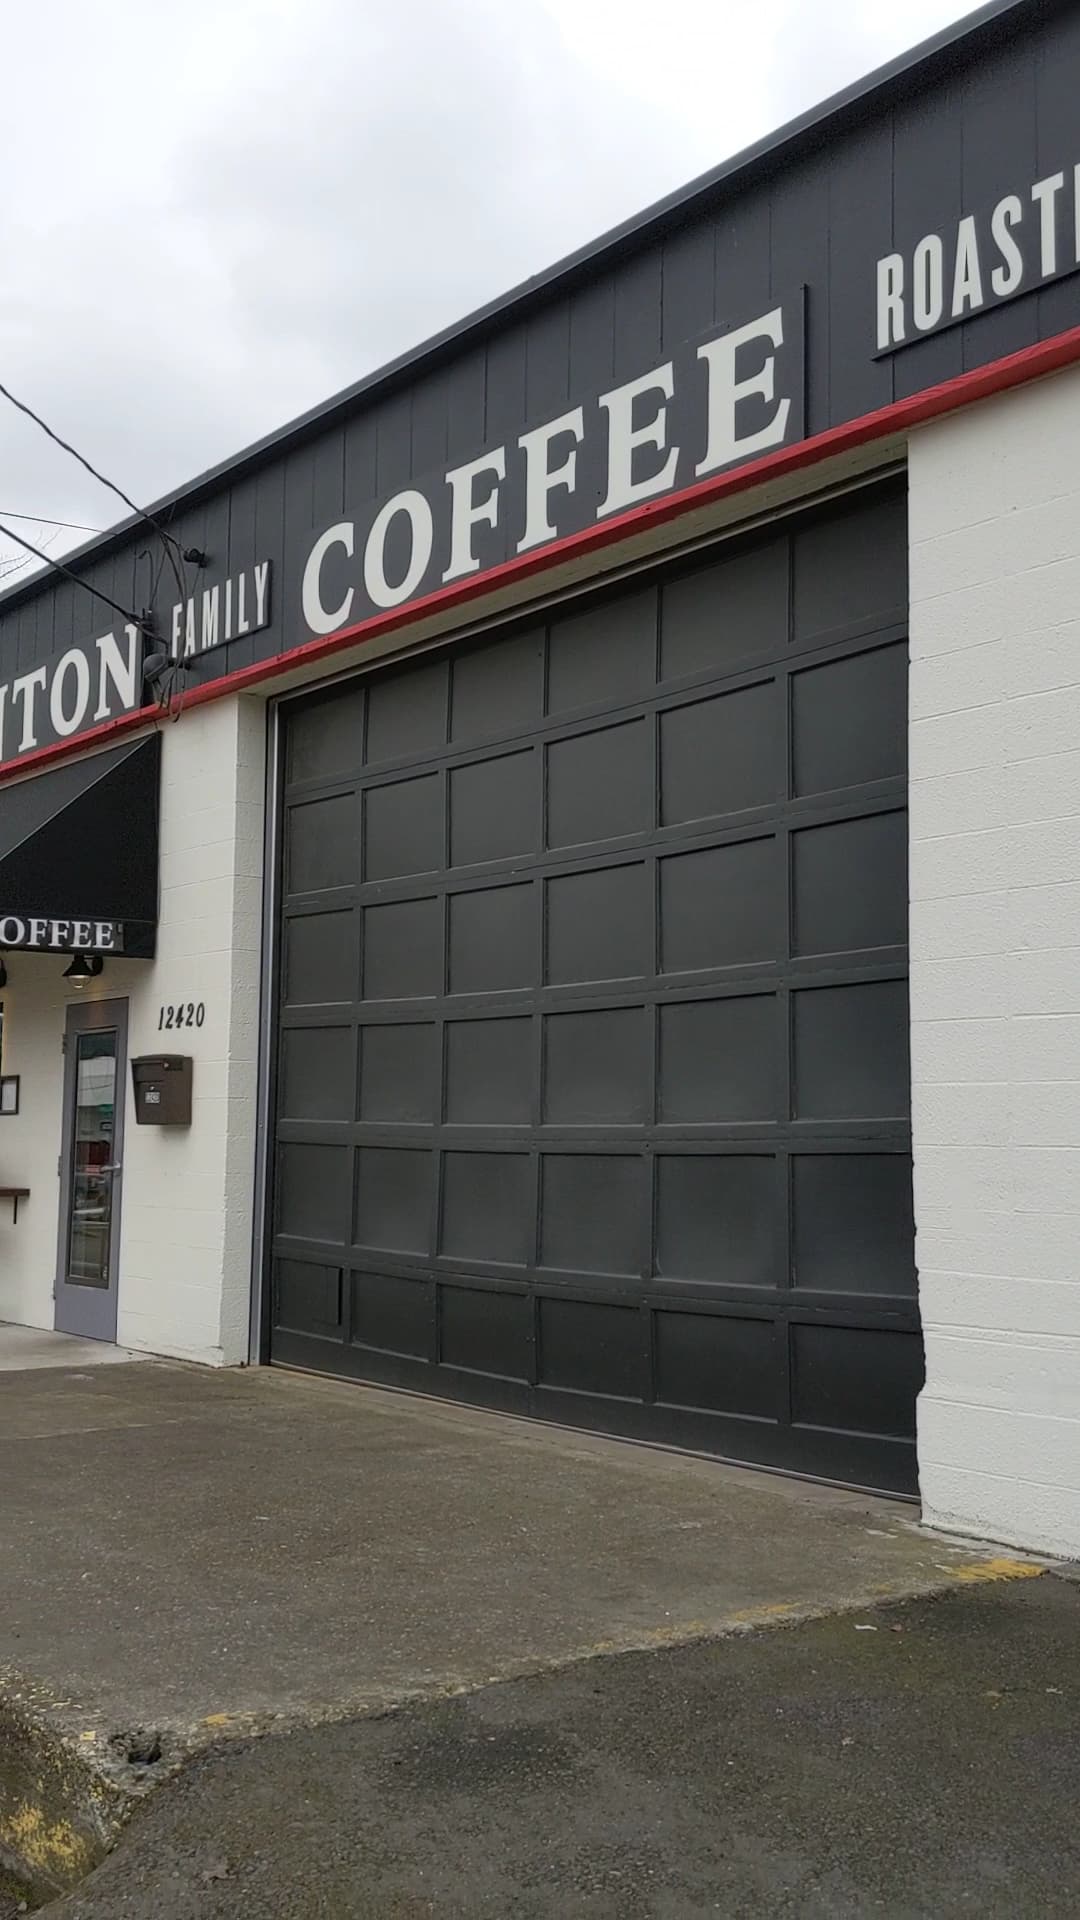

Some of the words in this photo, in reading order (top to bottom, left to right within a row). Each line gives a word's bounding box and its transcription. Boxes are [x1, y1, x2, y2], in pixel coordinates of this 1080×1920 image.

[171, 561, 269, 658] FAMILY
[302, 306, 791, 634] COFFEE
[158, 1002, 205, 1031] 12420
